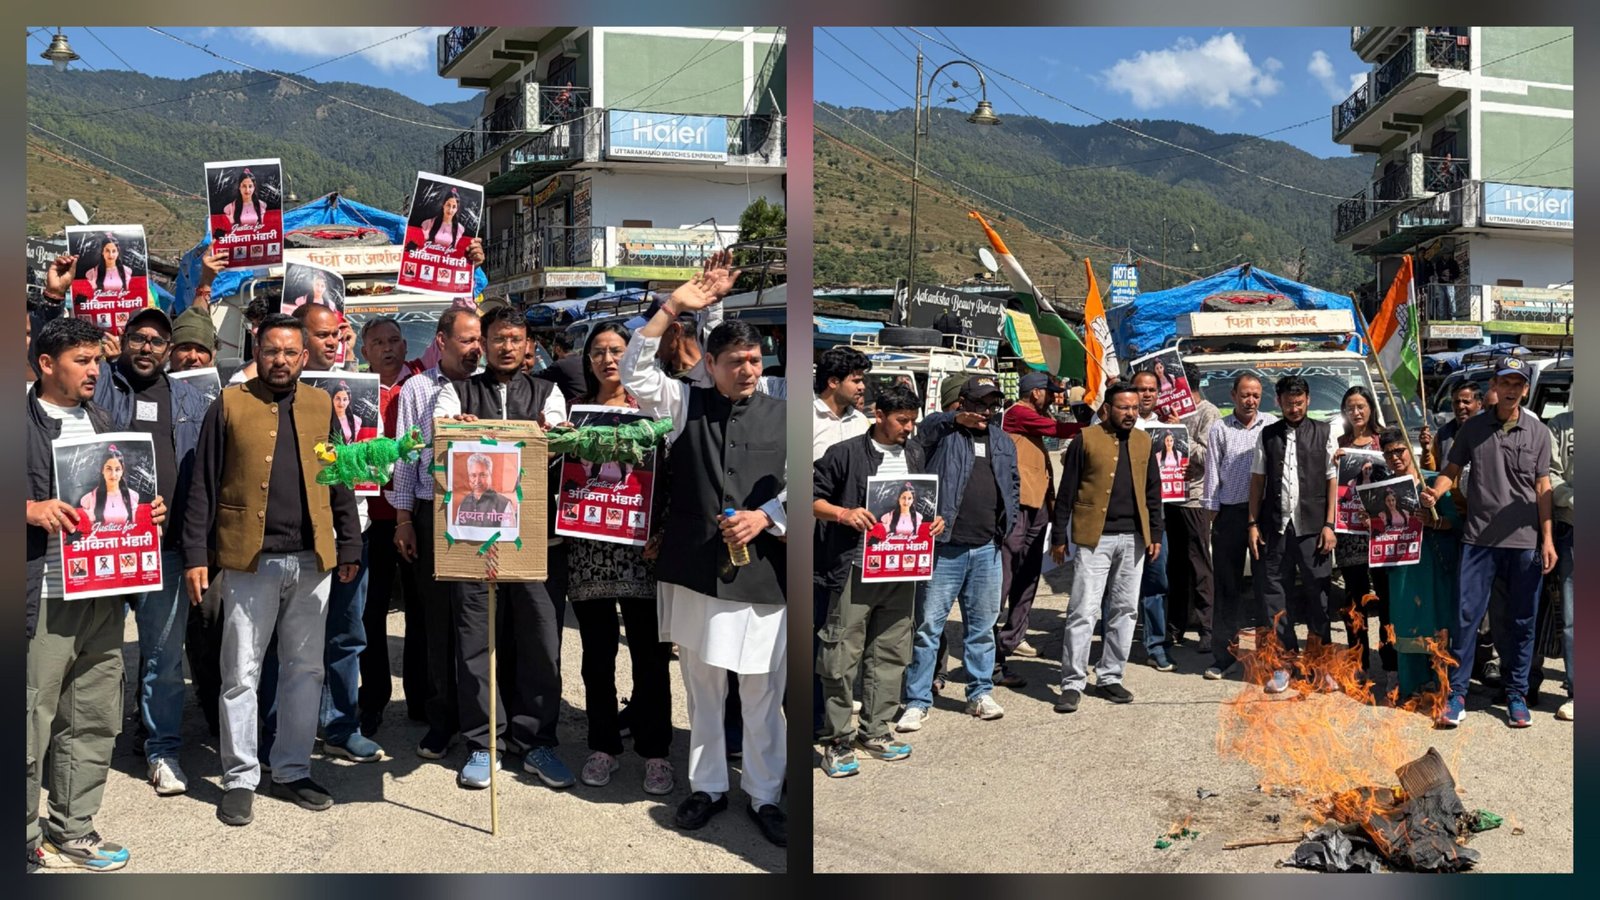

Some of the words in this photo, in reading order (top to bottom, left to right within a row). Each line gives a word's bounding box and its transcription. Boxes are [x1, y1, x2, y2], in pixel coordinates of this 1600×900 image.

[633, 117, 705, 144] Haier
[614, 148, 660, 156] UTTARAKHAND
[662, 150, 690, 158] WATCHES
[1505, 189, 1568, 214] Haier
[253, 222, 264, 232] for
[218, 234, 251, 244] अंकिता
[253, 230, 277, 242] भंडारी
[344, 254, 361, 265] का
[409, 249, 441, 263] अंकिता
[442, 253, 467, 267] भंडारी
[1112, 266, 1137, 279] HOTEL
[119, 287, 130, 298] for
[80, 298, 115, 311] अंकिता
[117, 296, 143, 309] भंडारी
[912, 288, 950, 307] Aakanksha
[951, 294, 975, 317] Beauty
[975, 299, 999, 317] Parlour
[1256, 315, 1270, 327] का
[586, 477, 614, 491] Justice
[613, 480, 629, 493] for
[568, 488, 608, 503] अंकिता
[610, 491, 644, 507] भंडारी
[459, 508, 484, 524] दुष्यंत
[91, 522, 122, 537] Justice
[123, 519, 137, 533] for
[72, 536, 118, 552] अंकिता
[121, 531, 153, 546] भंडारी
[872, 541, 904, 552] अंकिता
